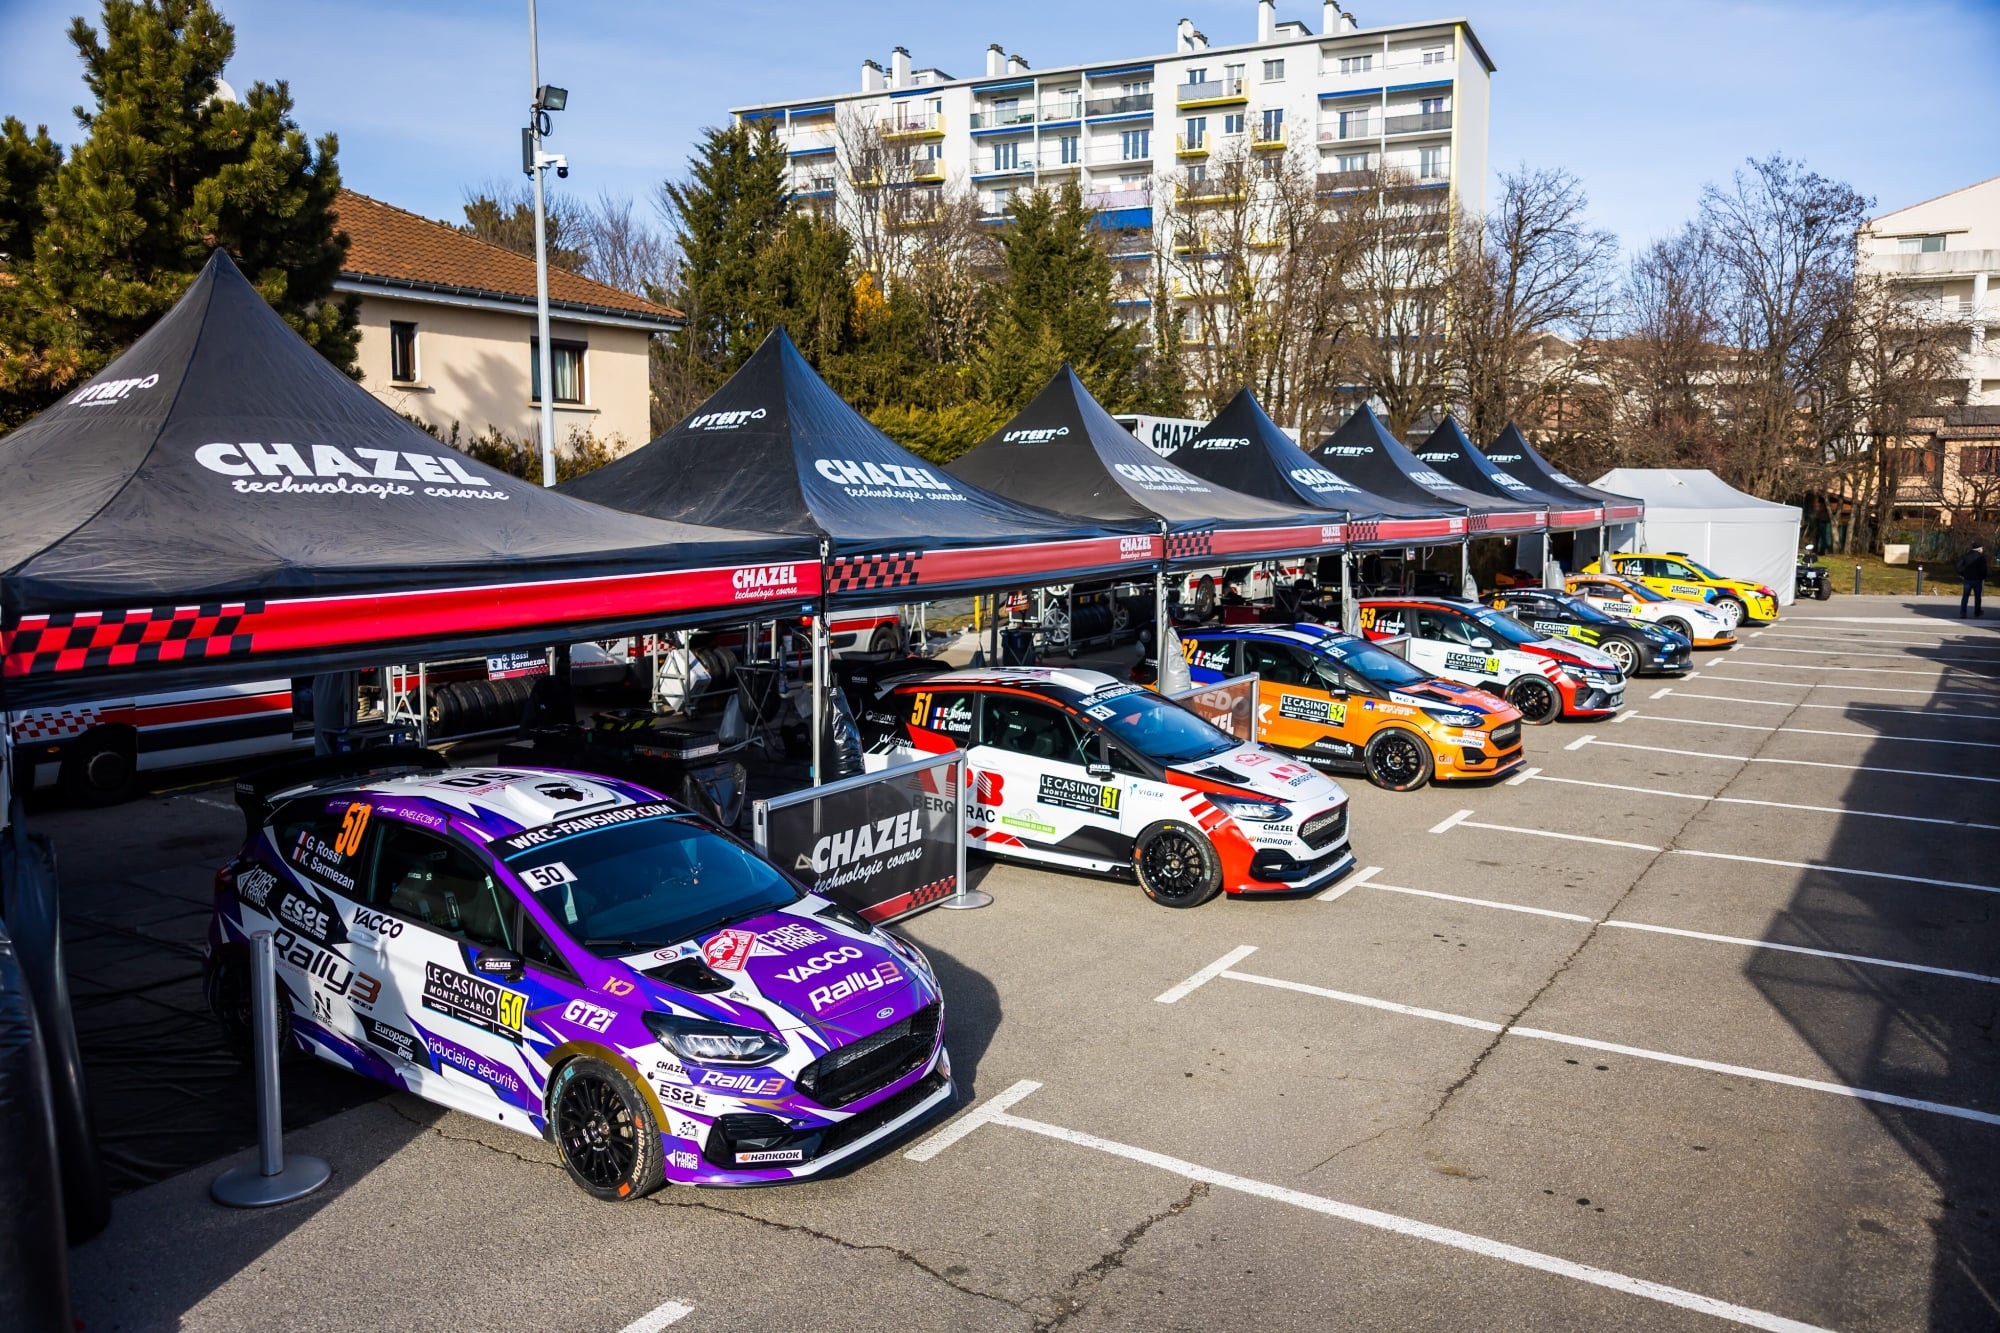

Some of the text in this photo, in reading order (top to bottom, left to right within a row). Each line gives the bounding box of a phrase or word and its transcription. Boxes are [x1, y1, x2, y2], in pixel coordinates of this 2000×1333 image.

[195, 442, 491, 487] CHAZEL
[814, 459, 952, 491] CHAZEL
[1114, 463, 1198, 485] CHAZEL
[232, 476, 509, 501] technologie course
[1120, 536, 1151, 552] CHAZEL
[732, 566, 797, 589] CHAZEL
[735, 586, 797, 600] technologie course
[1360, 608, 1376, 629] 53
[1543, 623, 1568, 631] CASINO
[511, 651, 529, 661] Rossi
[1182, 638, 1198, 664] 52
[1456, 653, 1486, 664] CASINO
[503, 659, 546, 670] K. Sarmezan
[911, 692, 932, 726] 51
[1283, 696, 1328, 711] LE CASINO
[1329, 703, 1345, 721] 52
[940, 719, 971, 732] A. Grenier
[1041, 776, 1099, 797] LE CASINO
[1102, 786, 1118, 810] 51
[1138, 789, 1164, 798] VIGIER
[912, 794, 996, 823] BERGRAC
[335, 802, 372, 857] 50
[506, 804, 674, 850] WRC-FANSHOP.COM
[1263, 823, 1294, 833] CHAZEL
[306, 835, 343, 865] G. Rossi
[812, 809, 922, 874] CHAZEL
[300, 850, 355, 891] K. Sarmezan
[531, 866, 564, 887] 50
[813, 847, 923, 893] technologie course
[352, 907, 403, 939] YACCO
[774, 946, 863, 984] YACCO
[427, 966, 496, 1006] LE CASINO
[500, 990, 523, 1031] 50
[375, 1021, 413, 1046] Europcar
[477, 1062, 519, 1092] sécurité
[656, 1061, 691, 1075] CHAZEL
